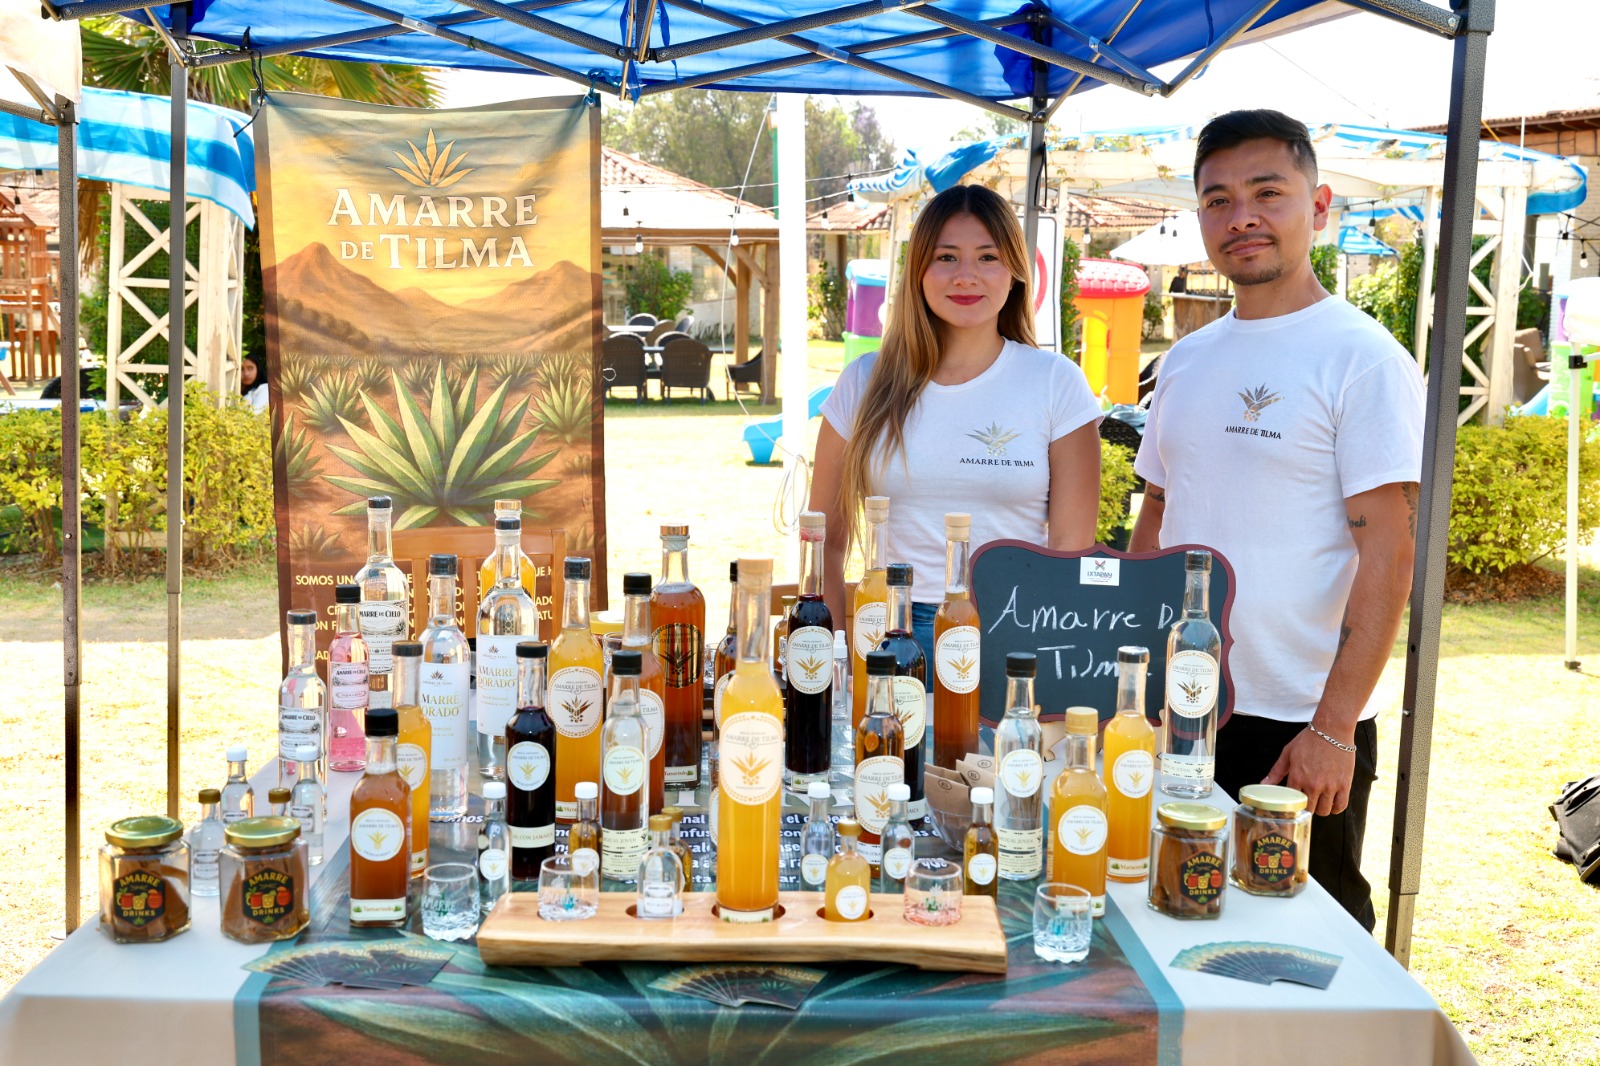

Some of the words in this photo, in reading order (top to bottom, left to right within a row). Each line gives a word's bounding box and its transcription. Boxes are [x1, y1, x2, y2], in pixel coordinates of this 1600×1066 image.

[327, 188, 538, 229] AMARRE
[340, 240, 374, 261] DE
[379, 233, 535, 270] TILMA
[1225, 426, 1250, 434] AMARRE
[1250, 428, 1259, 436] DE
[1260, 429, 1282, 440] TILMA
[960, 458, 1000, 466] AMARRE
[296, 575, 334, 586] SOMOS
[988, 585, 1142, 634] Amarre
[422, 694, 458, 705] MARRE
[422, 706, 460, 716] ORADO
[1257, 836, 1291, 848] AMARRE
[1186, 856, 1222, 867] AMARRE
[120, 874, 160, 887] AMARRE
[249, 873, 288, 885] AMARRE
[252, 908, 285, 916] DRINKS
